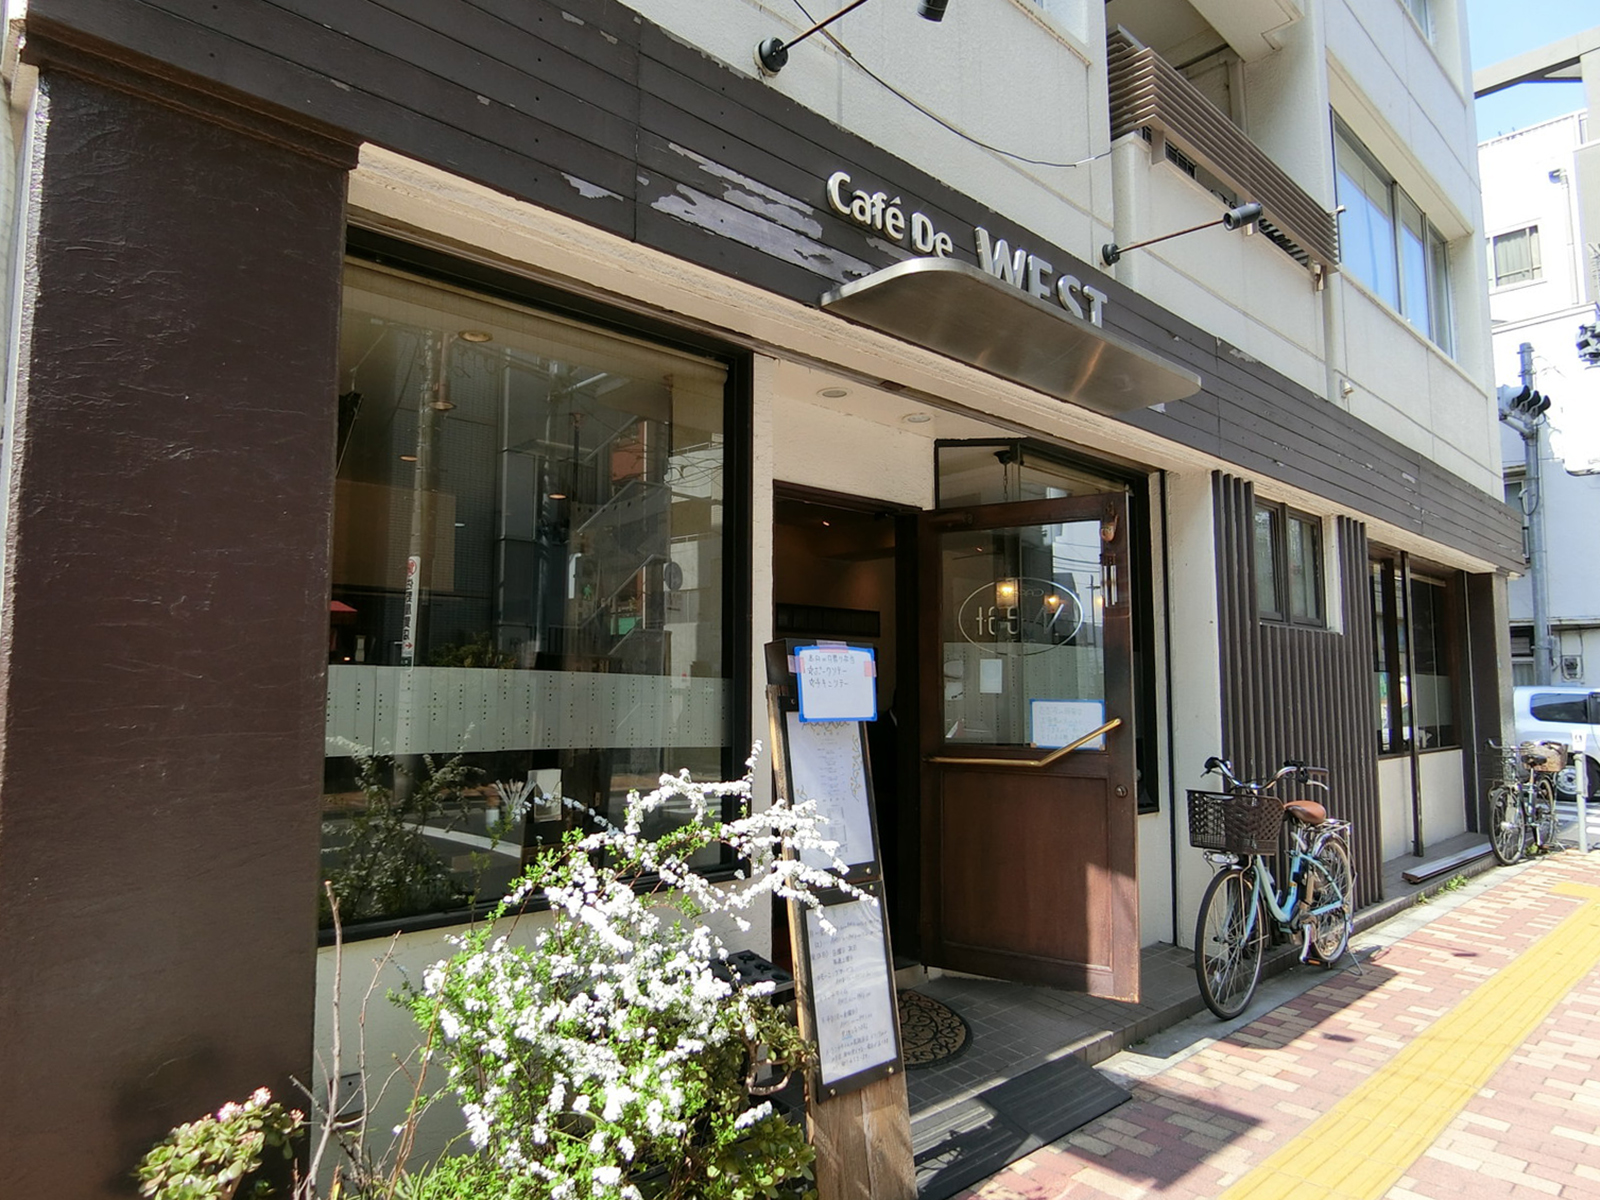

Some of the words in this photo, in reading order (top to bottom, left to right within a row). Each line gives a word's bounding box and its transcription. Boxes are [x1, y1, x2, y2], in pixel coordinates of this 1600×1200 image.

[826, 171, 905, 241] Café
[911, 211, 954, 258] De
[974, 226, 1108, 328] WEST
